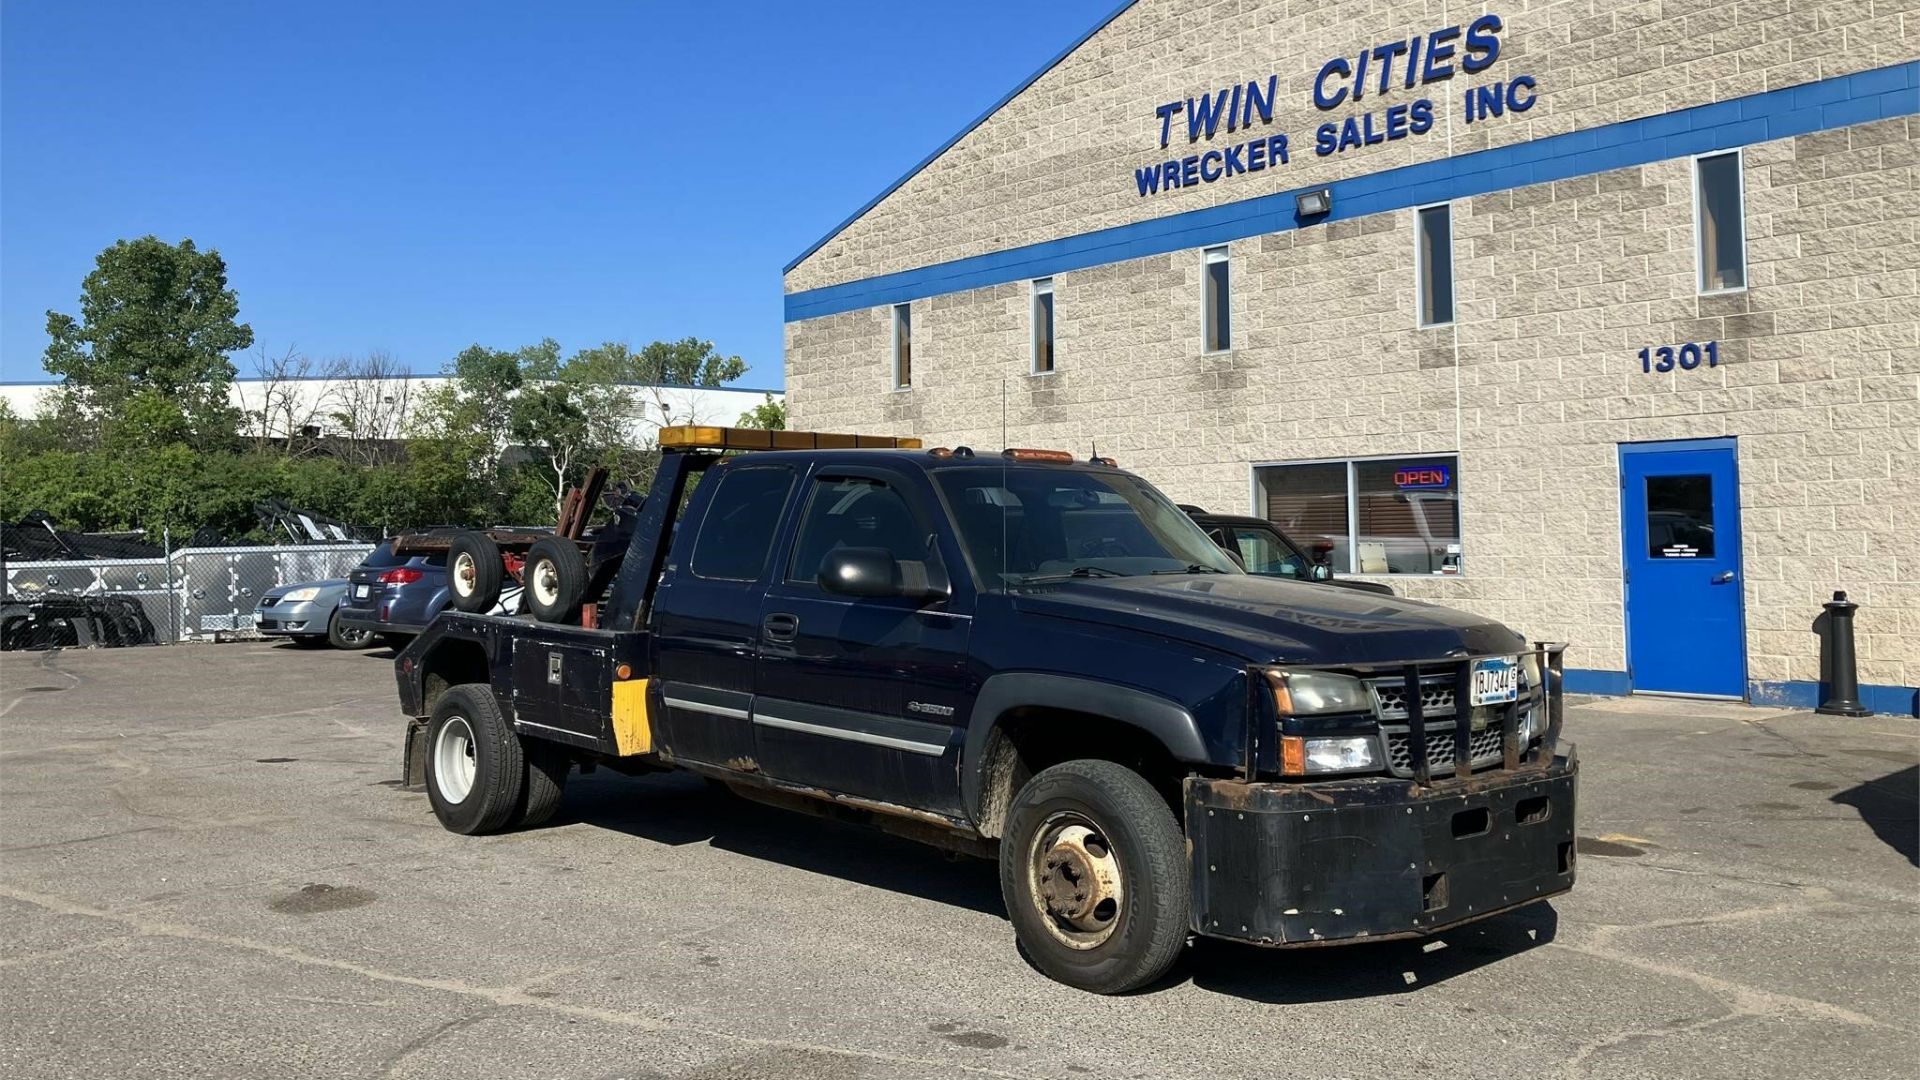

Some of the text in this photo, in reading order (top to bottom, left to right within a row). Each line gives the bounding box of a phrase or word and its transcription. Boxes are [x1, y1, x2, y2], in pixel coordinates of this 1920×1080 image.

[1156, 14, 1501, 147] TWIN CITIES
[1135, 75, 1535, 195] WRECKER SALES INC
[1638, 341, 1718, 373] 1301
[1394, 470, 1443, 485] OPEN
